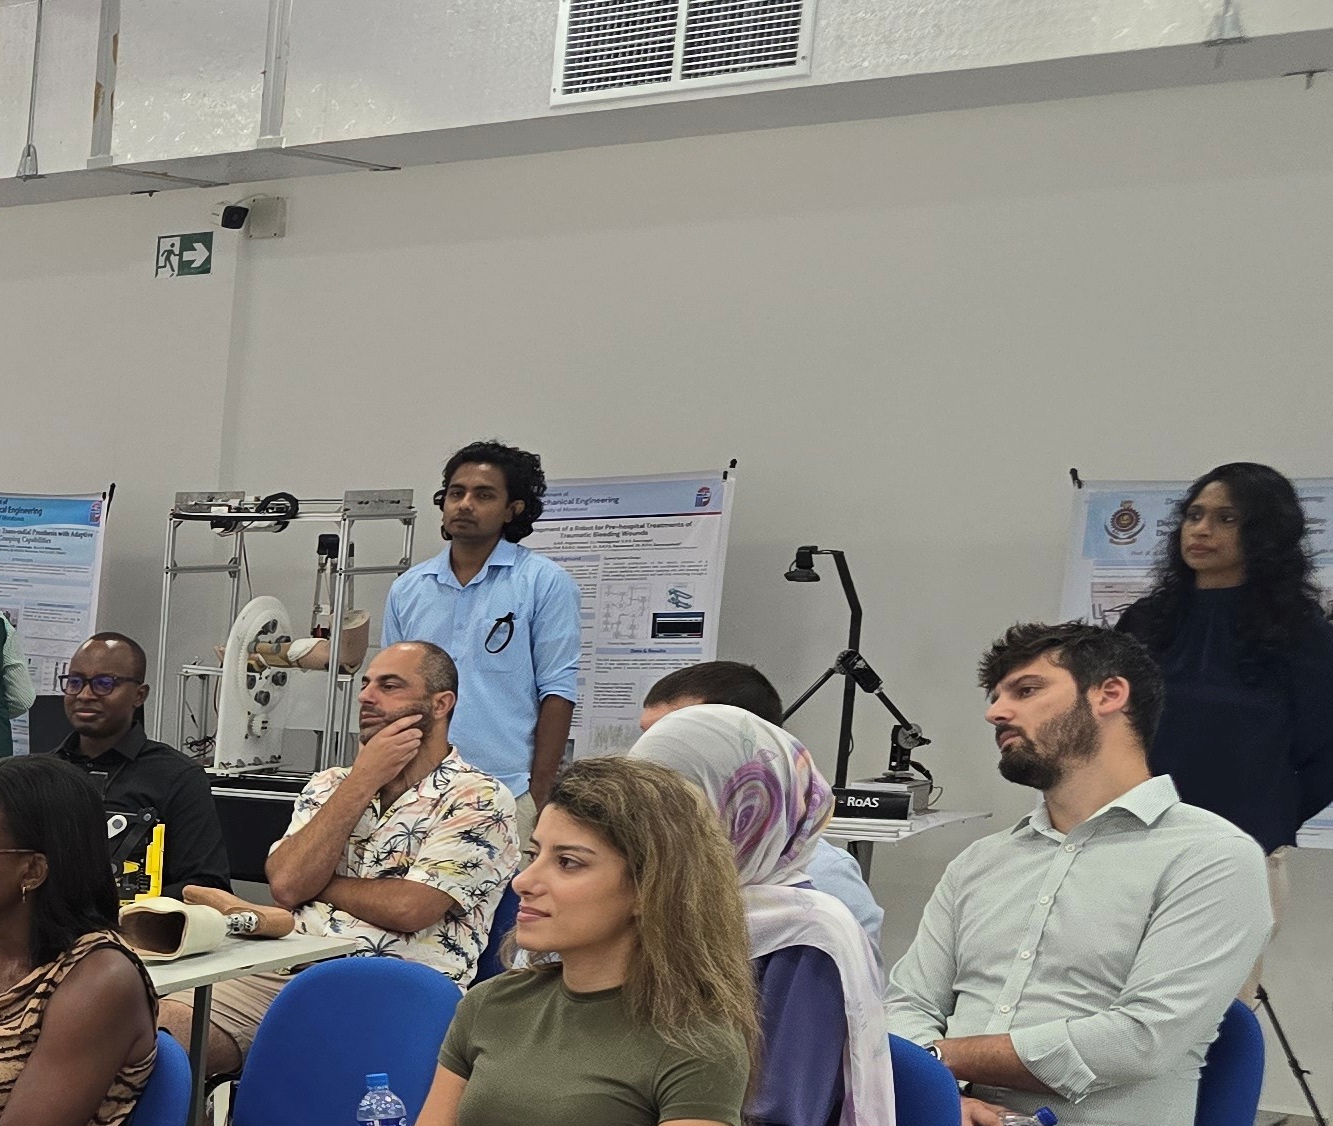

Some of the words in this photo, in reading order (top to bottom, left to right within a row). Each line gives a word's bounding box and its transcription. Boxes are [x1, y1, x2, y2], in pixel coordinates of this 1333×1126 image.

[575, 497, 620, 506] Engineering
[8, 506, 43, 517] Engineering
[846, 796, 880, 808] RoAS
